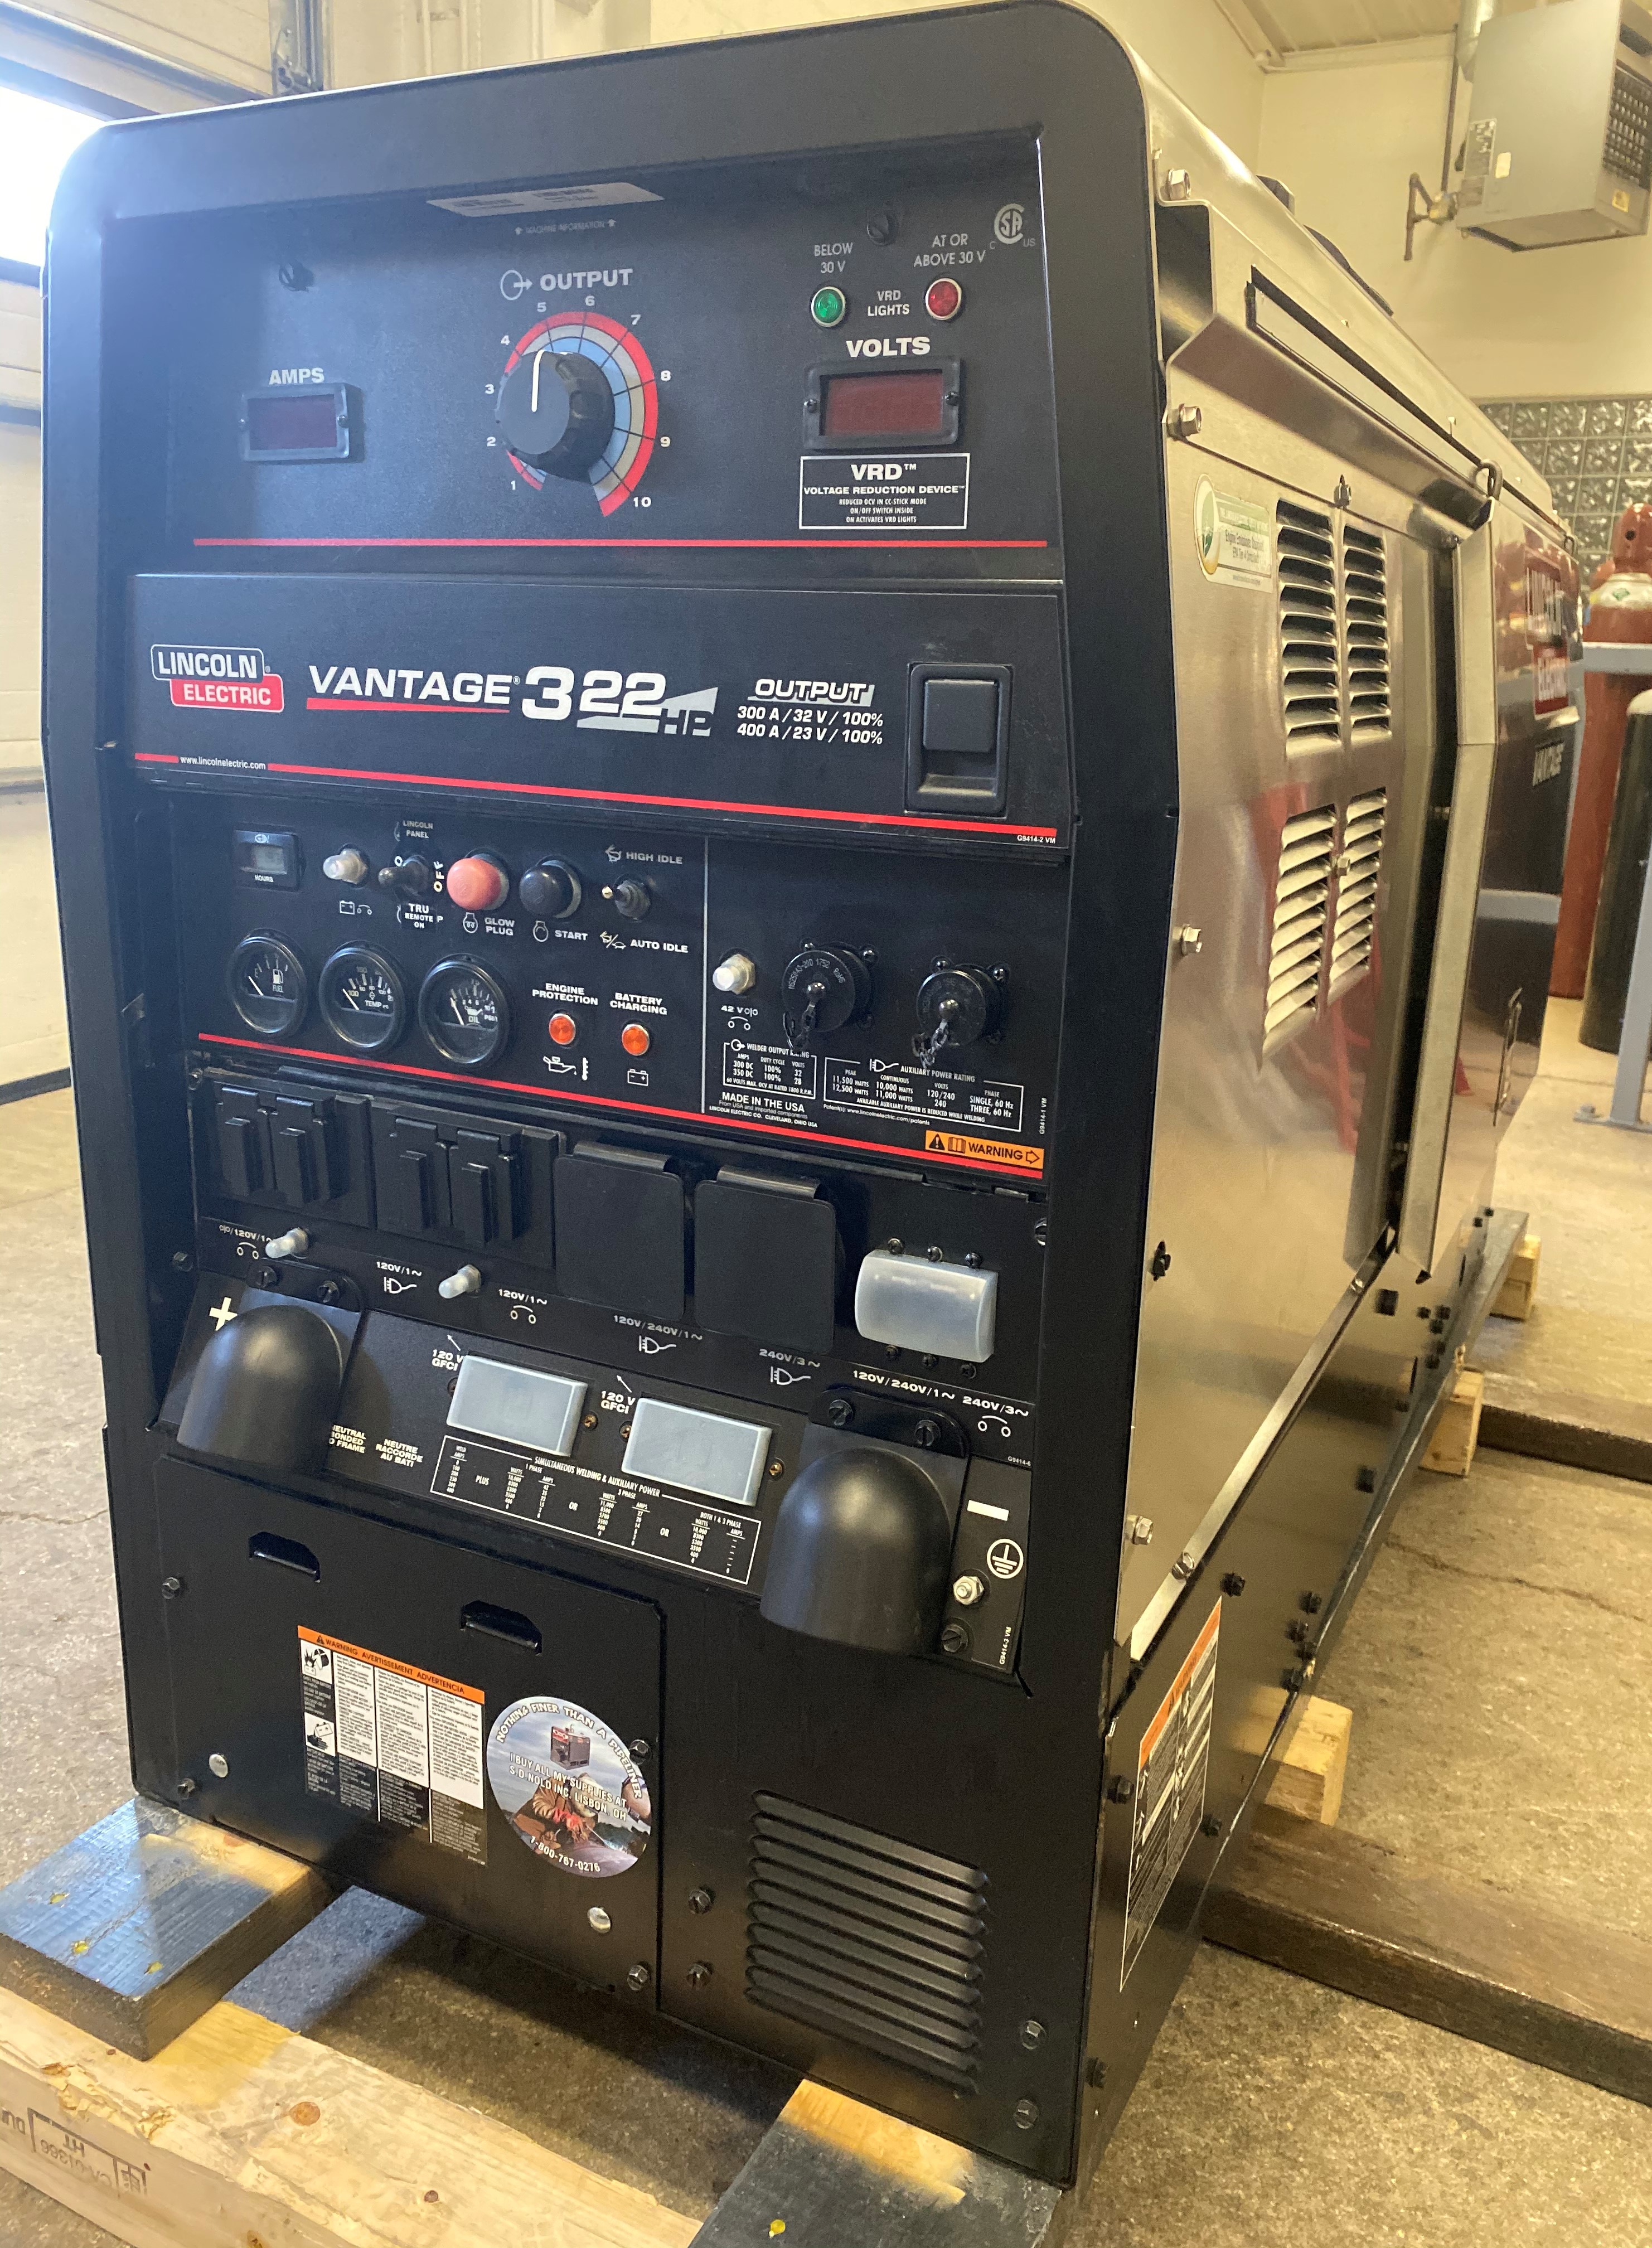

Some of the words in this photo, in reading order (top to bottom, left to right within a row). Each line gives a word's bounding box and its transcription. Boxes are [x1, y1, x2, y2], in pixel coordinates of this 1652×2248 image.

[932, 235, 947, 248] AT
[949, 233, 968, 246] OR
[814, 243, 853, 257] BELOW
[913, 252, 956, 267] ABOVE
[958, 251, 973, 264] 30
[976, 250, 986, 263] V
[820, 262, 833, 273] 30
[836, 260, 846, 272] V
[540, 269, 633, 292] OUTPUT
[585, 295, 595, 306] 6
[876, 289, 901, 302] VRD
[537, 303, 547, 312] 5
[867, 304, 910, 317] LIGHTS
[632, 314, 642, 324] 7
[501, 336, 510, 345] 4
[846, 337, 931, 357] VOLTS
[269, 367, 324, 385] AMPS
[660, 370, 671, 381] 8
[485, 384, 495, 394] 3
[487, 437, 496, 446] 2
[660, 437, 671, 447] 9
[511, 481, 516, 490] 1
[853, 486, 915, 495] REDUCTION
[633, 497, 651, 507] 10
[158, 651, 256, 679] LINCOLN
[184, 683, 272, 705] ELECTRIC
[522, 666, 667, 721] 322
[755, 679, 866, 701] OUTPUT
[738, 706, 766, 720] 300
[769, 708, 779, 721] A
[793, 709, 813, 723] 32
[817, 710, 827, 723] V
[842, 711, 883, 727] 100%
[737, 723, 766, 737] 400
[769, 725, 779, 738] A
[793, 726, 812, 740] 23
[816, 728, 827, 740] V
[842, 729, 883, 744] 100%
[180, 755, 266, 770] www.lincolnelectric.com
[403, 820, 433, 830] LINCOLN
[406, 830, 429, 839] PANEL
[626, 851, 653, 862] HIGH
[658, 854, 683, 865] IDLE
[254, 874, 274, 883] HOURS
[408, 903, 429, 914] TRU
[404, 912, 433, 922] REMOTE
[485, 917, 515, 927] GLOW
[486, 926, 513, 936] PLUG
[555, 930, 588, 941] START
[630, 939, 660, 949] AUTO
[663, 942, 689, 953] IDLE
[272, 984, 284, 993] FUEL
[545, 983, 585, 995] ENGINE
[532, 990, 598, 1005] PROTECTION
[615, 992, 662, 1005] BATTERY
[610, 1001, 667, 1015] CHARGING
[747, 1043, 767, 1053] WELDER
[768, 1046, 789, 1056] OUTPUT
[764, 1065, 781, 1074] 100%
[900, 1065, 930, 1075] AUXILIARY
[932, 1070, 952, 1079] POWER
[953, 1073, 975, 1082] RATING
[764, 1073, 781, 1082] 100%
[880, 1074, 909, 1084] CONTINUOUS
[927, 1089, 955, 1100] 120/240
[722, 1092, 749, 1103] MADE
[752, 1097, 761, 1106] IN
[764, 1098, 782, 1108] THE
[785, 1101, 805, 1112] USA
[709, 1105, 730, 1113] LINCOLN
[731, 1108, 752, 1117] ELECTRIC
[765, 1115, 793, 1124] CLEVELAND,
[856, 1097, 879, 1106] AVAILABLE
[880, 1102, 903, 1110] AUXILIARY
[964, 1114, 985, 1122] WELDING
[968, 1142, 1023, 1160] WARNING
[432, 1349, 452, 1361] 120
[432, 1359, 458, 1371] GFCI
[601, 1391, 623, 1403] 120
[600, 1401, 629, 1414] GFCI
[337, 1441, 366, 1454] FRAME
[376, 1443, 423, 1462] RACCORDE
[384, 1439, 418, 1454] NEUTRE
[395, 1457, 414, 1467] BATI
[475, 1475, 490, 1486] PLUS
[534, 1456, 575, 1474] SIMULTANEOUS
[576, 1467, 602, 1481] WELDING
[608, 1476, 638, 1491] AUXILIARY
[638, 1484, 660, 1498] POWER
[569, 1501, 578, 1511] OR
[660, 1528, 670, 1537] OR
[326, 1639, 358, 1655] WARNING
[362, 1651, 413, 1675] AVERTISSEMENT
[416, 1672, 464, 1694] ADVERTENCIA
[496, 1706, 529, 1743] NOTHING
[531, 1703, 559, 1713] FINER
[563, 1706, 595, 1729] THAN
[597, 1728, 607, 1740] A
[608, 1739, 642, 1799] PIPELINER
[515, 1755, 534, 1769] BUY
[535, 1763, 550, 1777] ALL
[554, 1771, 568, 1784] MY
[569, 1776, 613, 1802] SUPPLIES
[613, 1808, 627, 1821] OH
[530, 1835, 600, 1872] 1-800-767-0276
